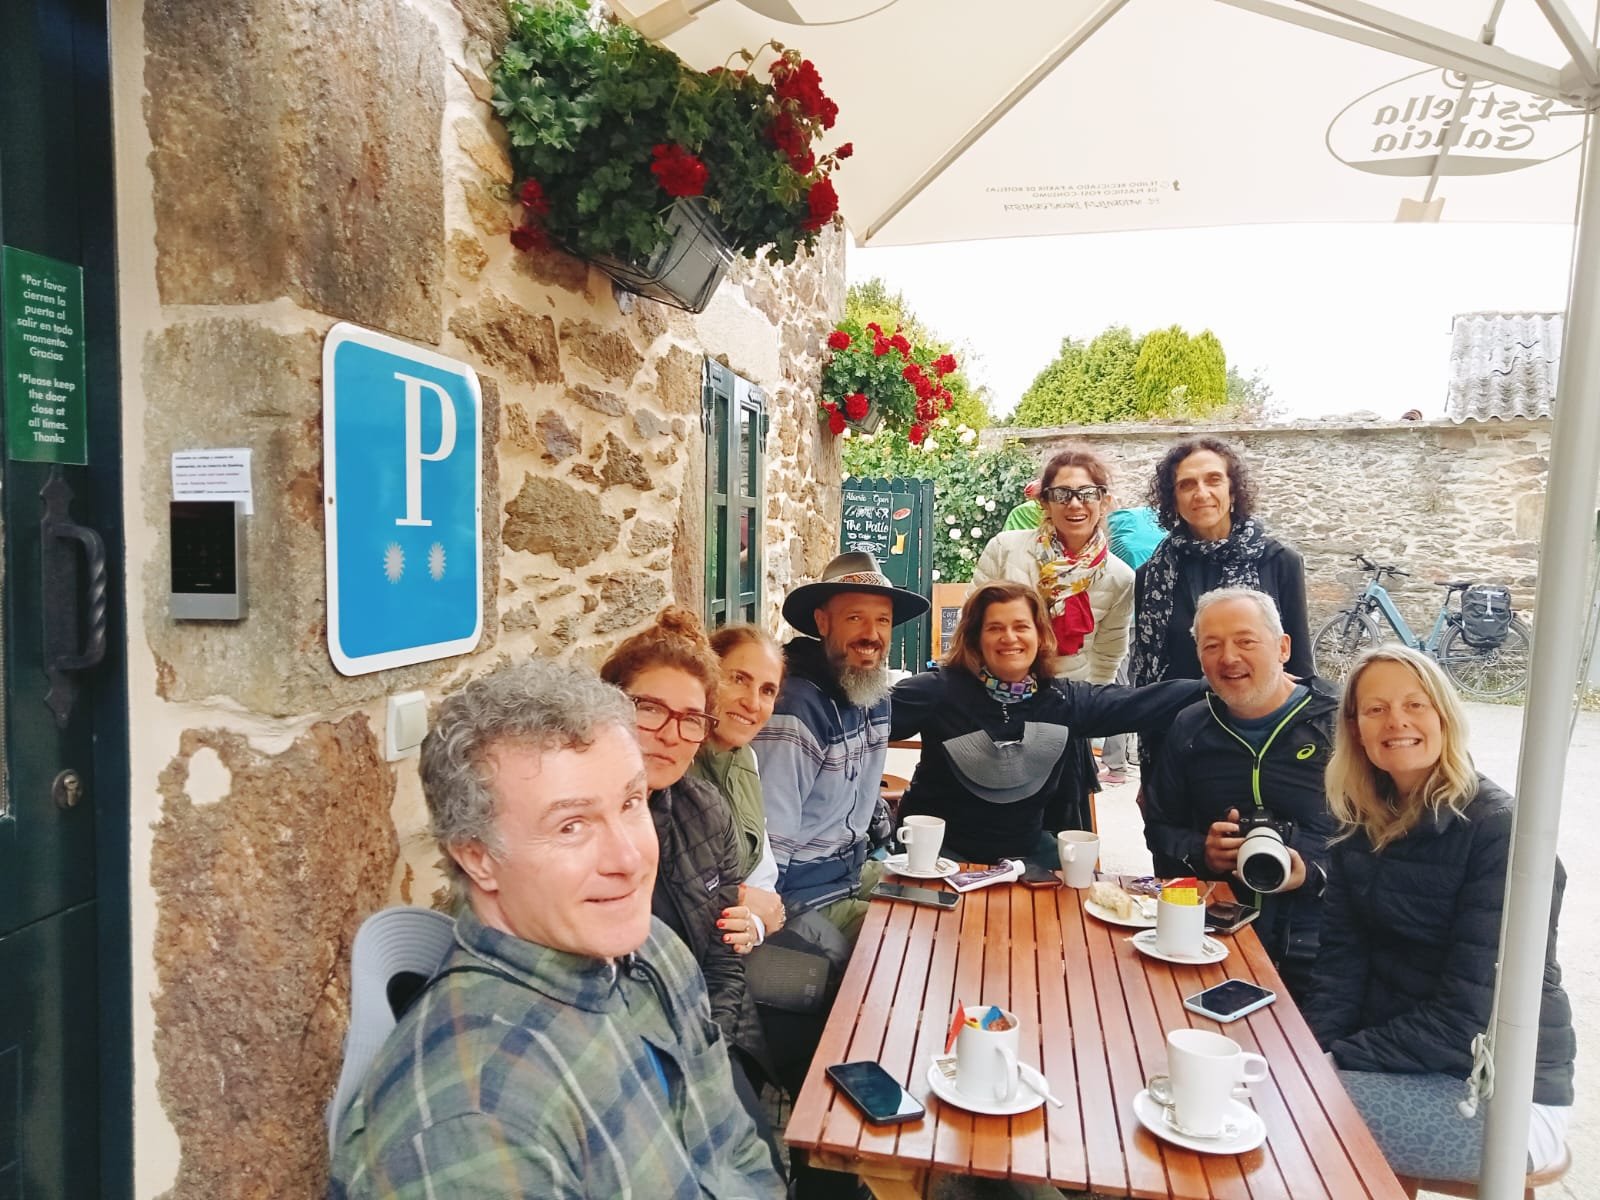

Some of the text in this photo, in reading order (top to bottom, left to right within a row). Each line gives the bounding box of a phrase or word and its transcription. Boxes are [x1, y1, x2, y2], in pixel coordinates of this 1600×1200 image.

[43, 278, 67, 293] favor
[23, 288, 66, 306] cierren la
[24, 305, 65, 320] puerta al
[17, 317, 73, 336] salir en todo
[23, 333, 69, 348] momento.
[29, 346, 64, 361] Gracias
[53, 378, 76, 392] keep
[28, 388, 67, 402] the door
[31, 403, 65, 416] close at
[28, 417, 69, 430] all times.
[33, 431, 66, 444] Thanks
[394, 371, 457, 527] P
[872, 493, 890, 506] Open
[843, 518, 889, 533] The Patio
